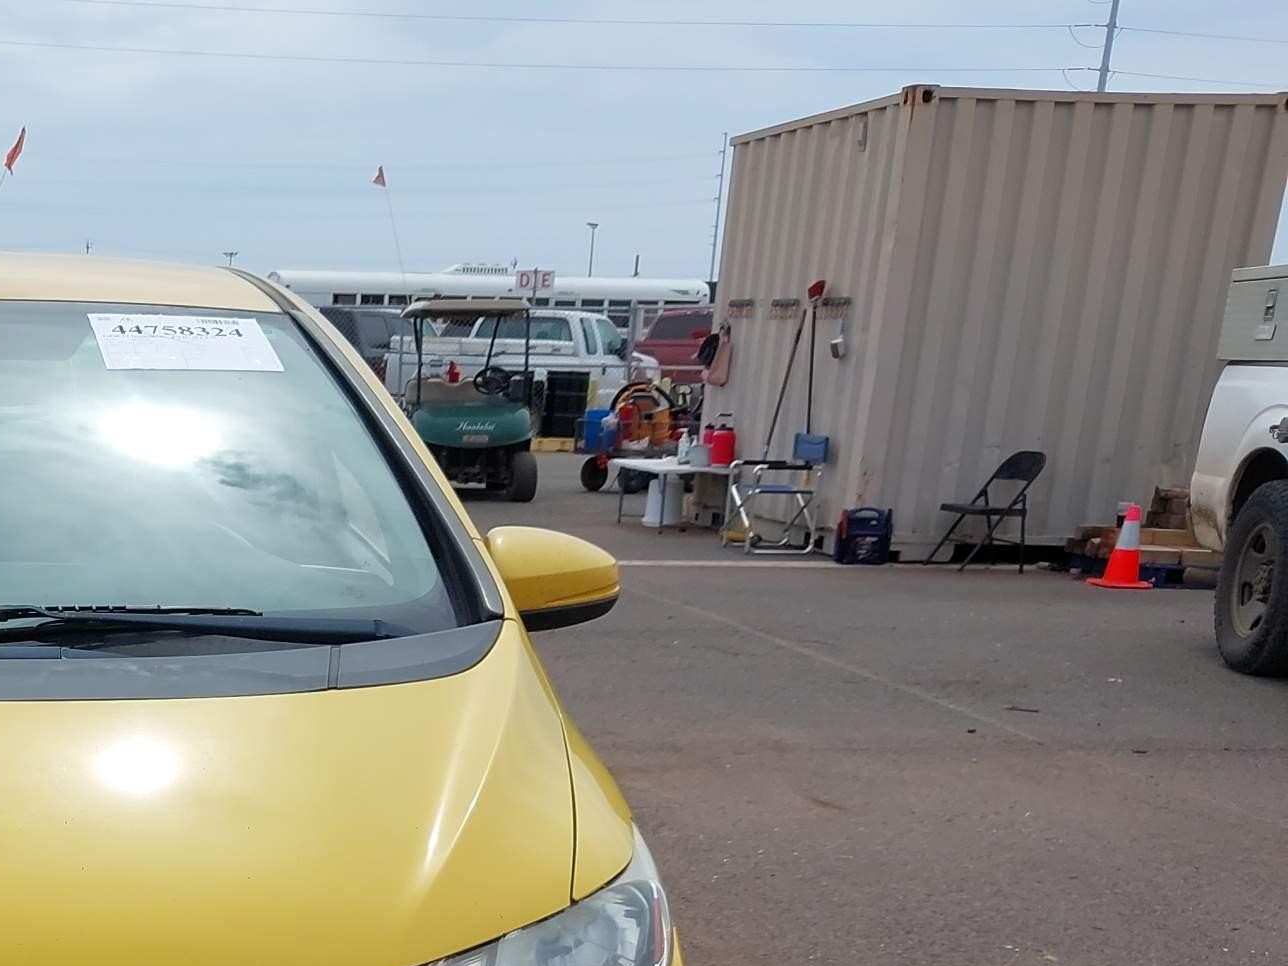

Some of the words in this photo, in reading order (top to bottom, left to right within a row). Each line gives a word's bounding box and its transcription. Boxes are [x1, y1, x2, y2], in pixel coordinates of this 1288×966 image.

[520, 272, 530, 288] D
[541, 273, 551, 288] E
[111, 324, 244, 338] 44758324
